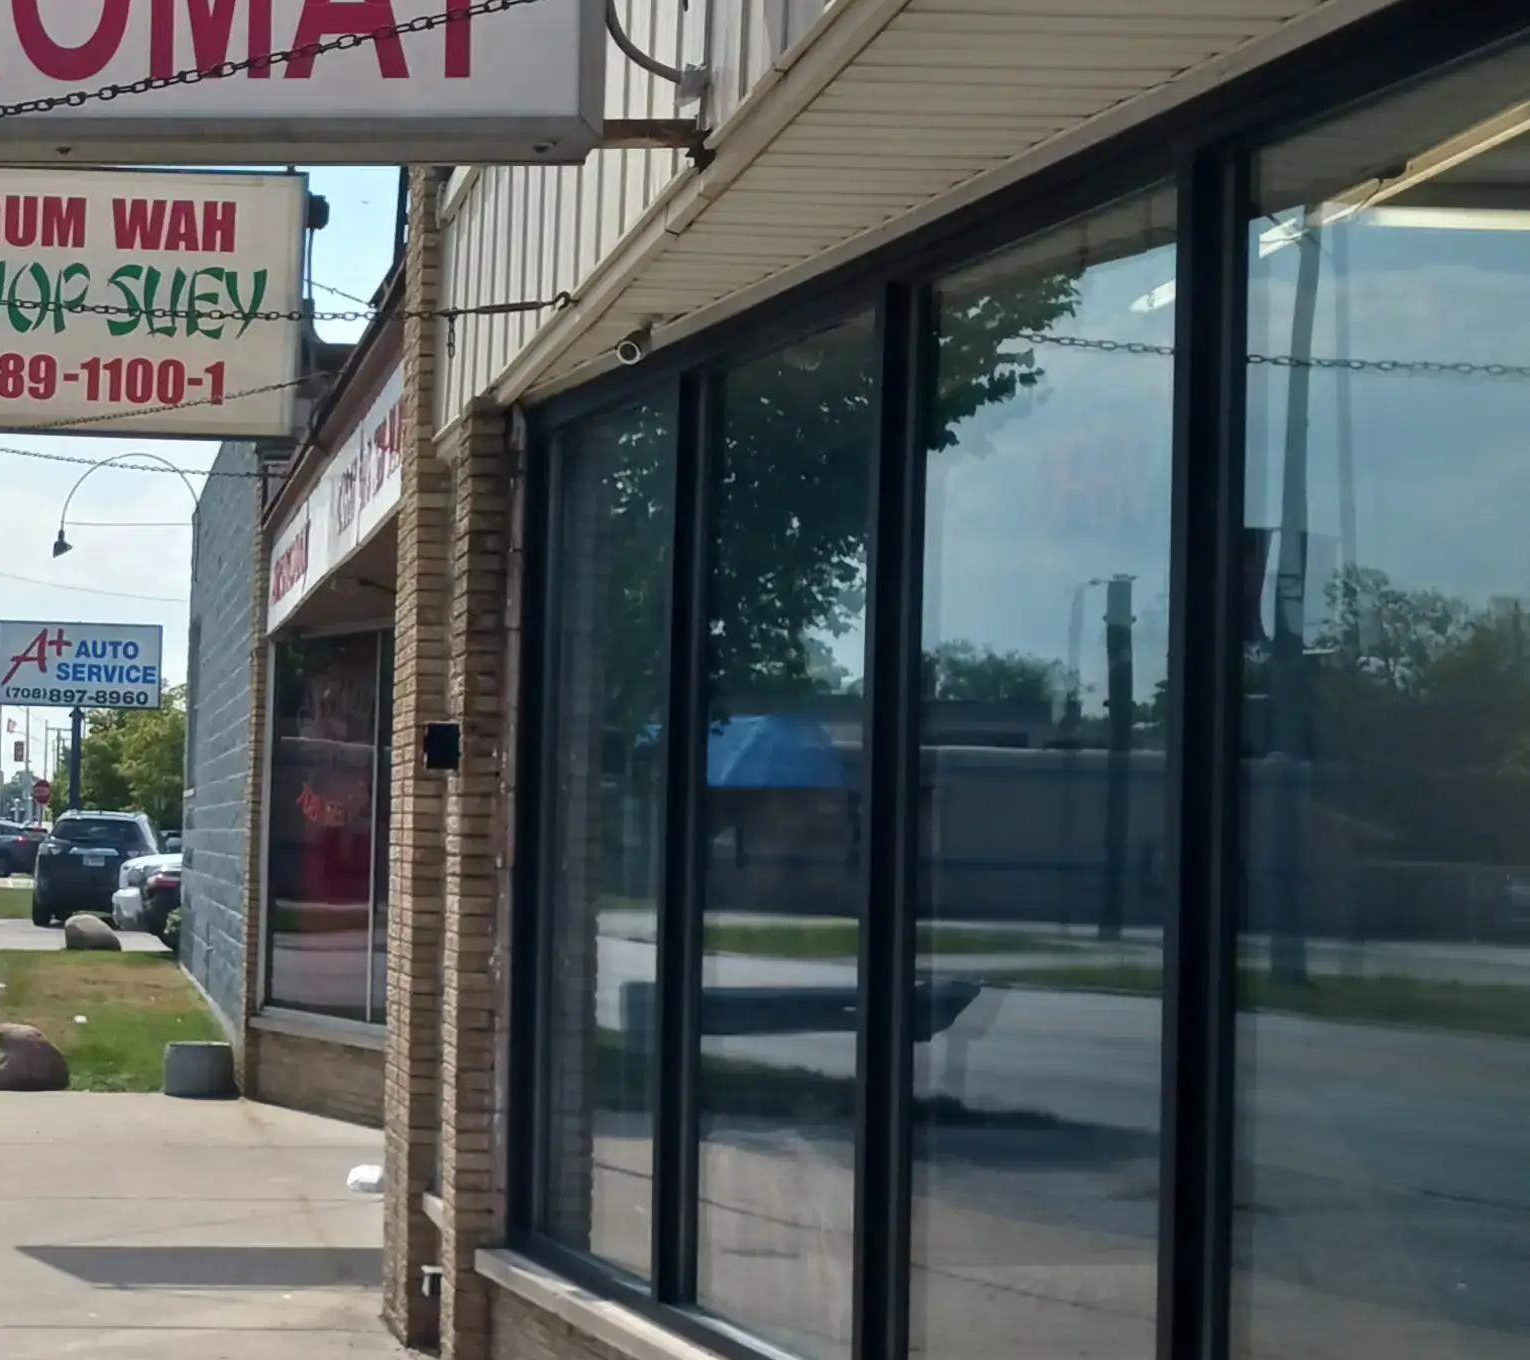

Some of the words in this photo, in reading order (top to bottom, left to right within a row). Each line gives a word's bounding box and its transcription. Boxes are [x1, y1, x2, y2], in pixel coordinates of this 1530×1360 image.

[112, 197, 236, 253] WAH
[107, 263, 268, 340] SUEY
[1, 627, 73, 687] A+
[75, 639, 139, 660] AUTO
[56, 662, 157, 685] SERVICE
